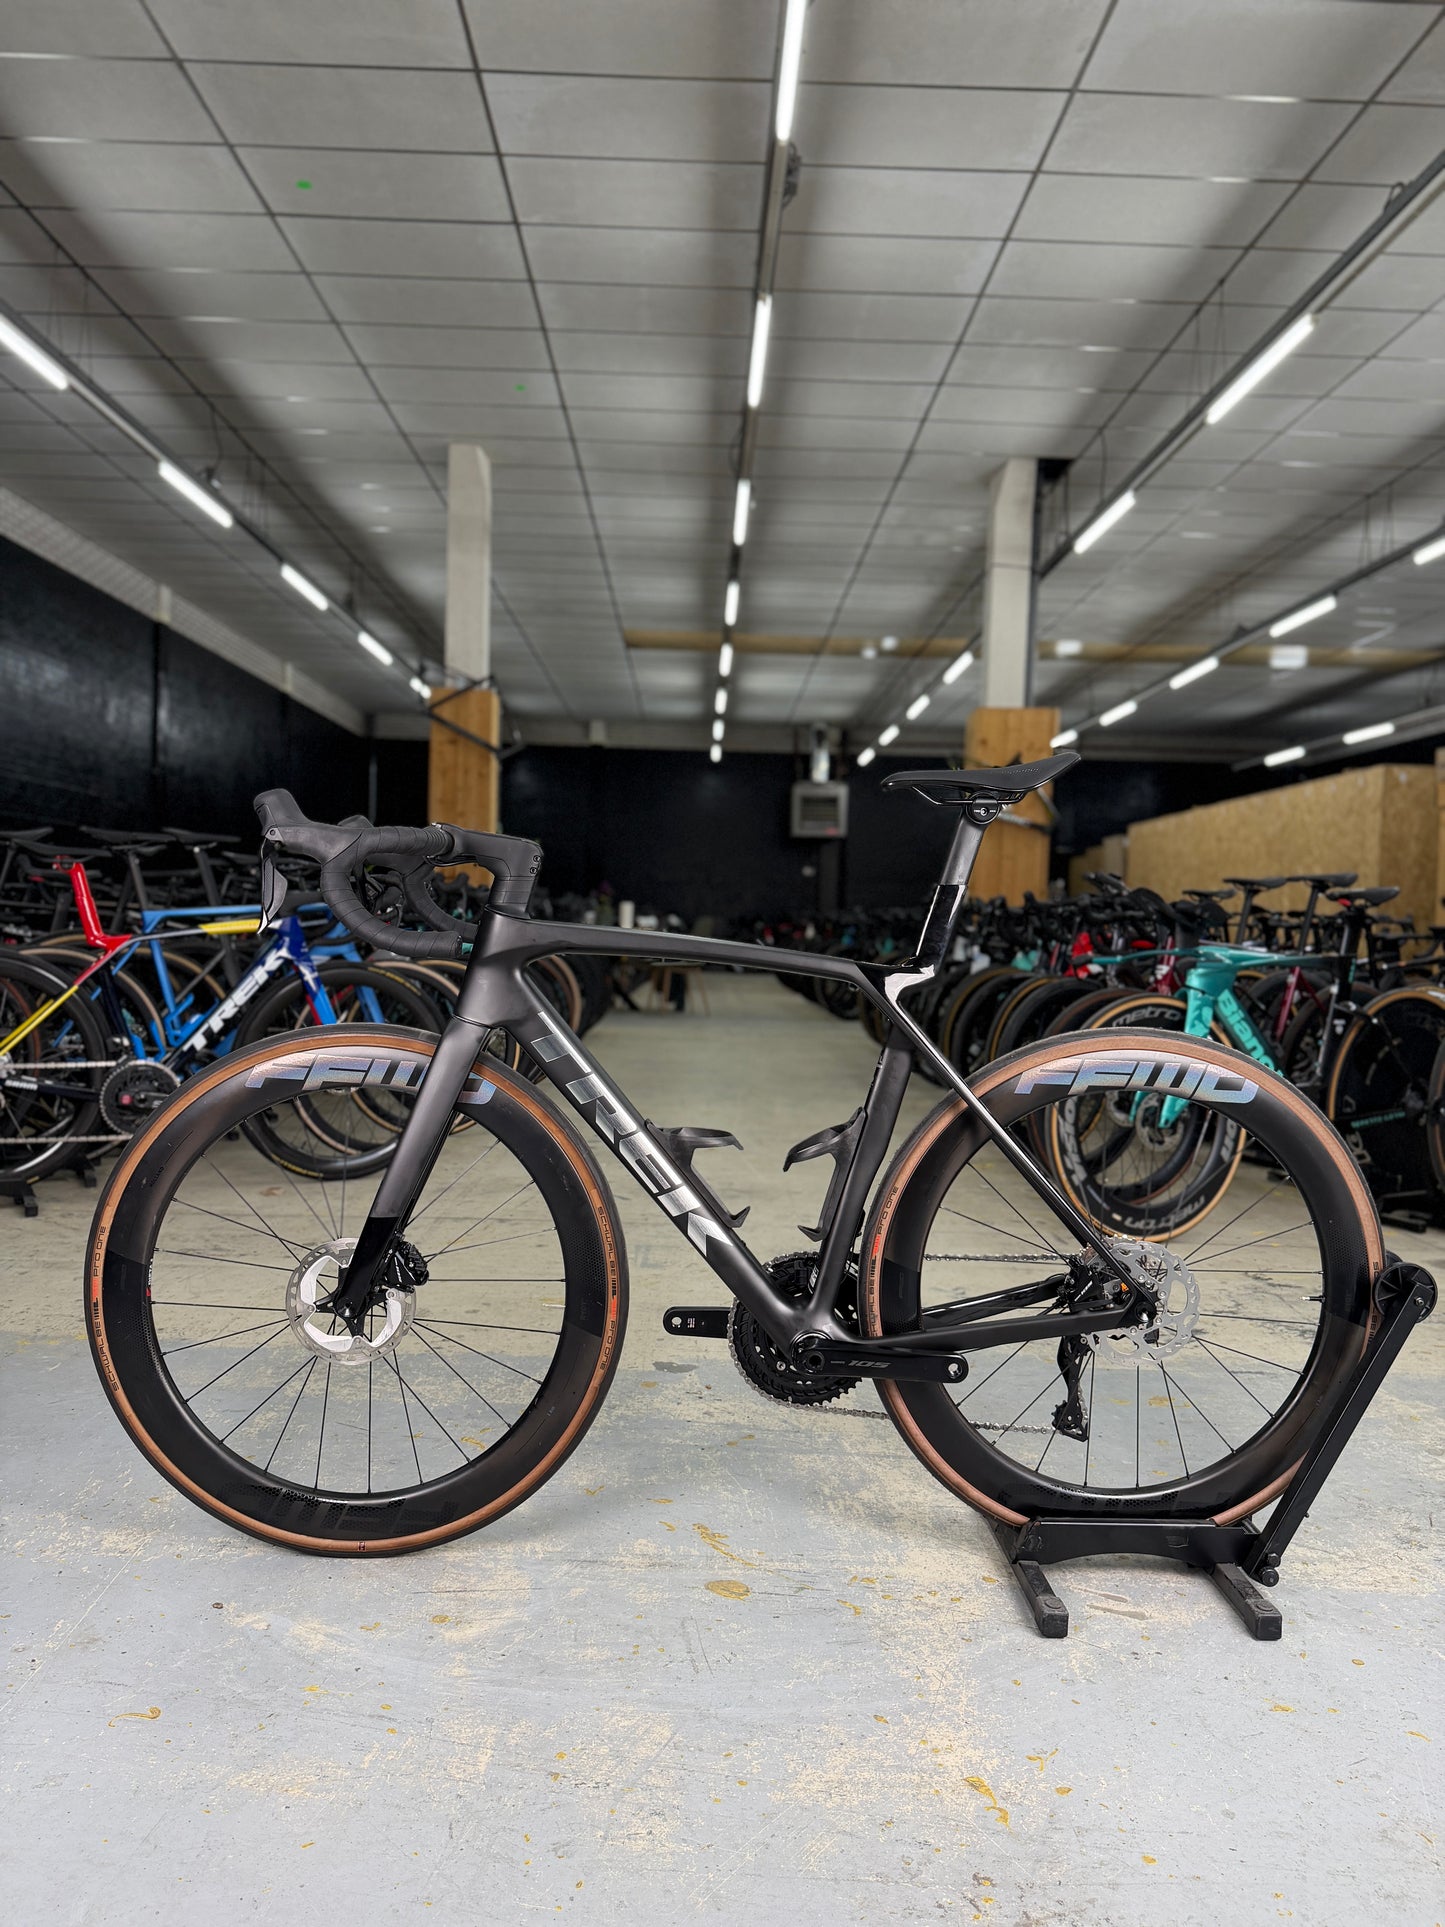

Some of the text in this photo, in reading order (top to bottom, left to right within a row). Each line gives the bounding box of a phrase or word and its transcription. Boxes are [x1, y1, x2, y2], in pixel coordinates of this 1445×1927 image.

[182, 947, 286, 1052] TREK
[1112, 1006, 1180, 1027] metro
[1014, 1057, 1260, 1104] FFWD
[531, 1011, 733, 1257] TREK
[1058, 1096, 1088, 1186] VISIO
[598, 1206, 616, 1278] SCHWALBE
[869, 1279, 878, 1337] HWALBE
[95, 1319, 119, 1392] SCHWALBE
[848, 1360, 892, 1368] 105
